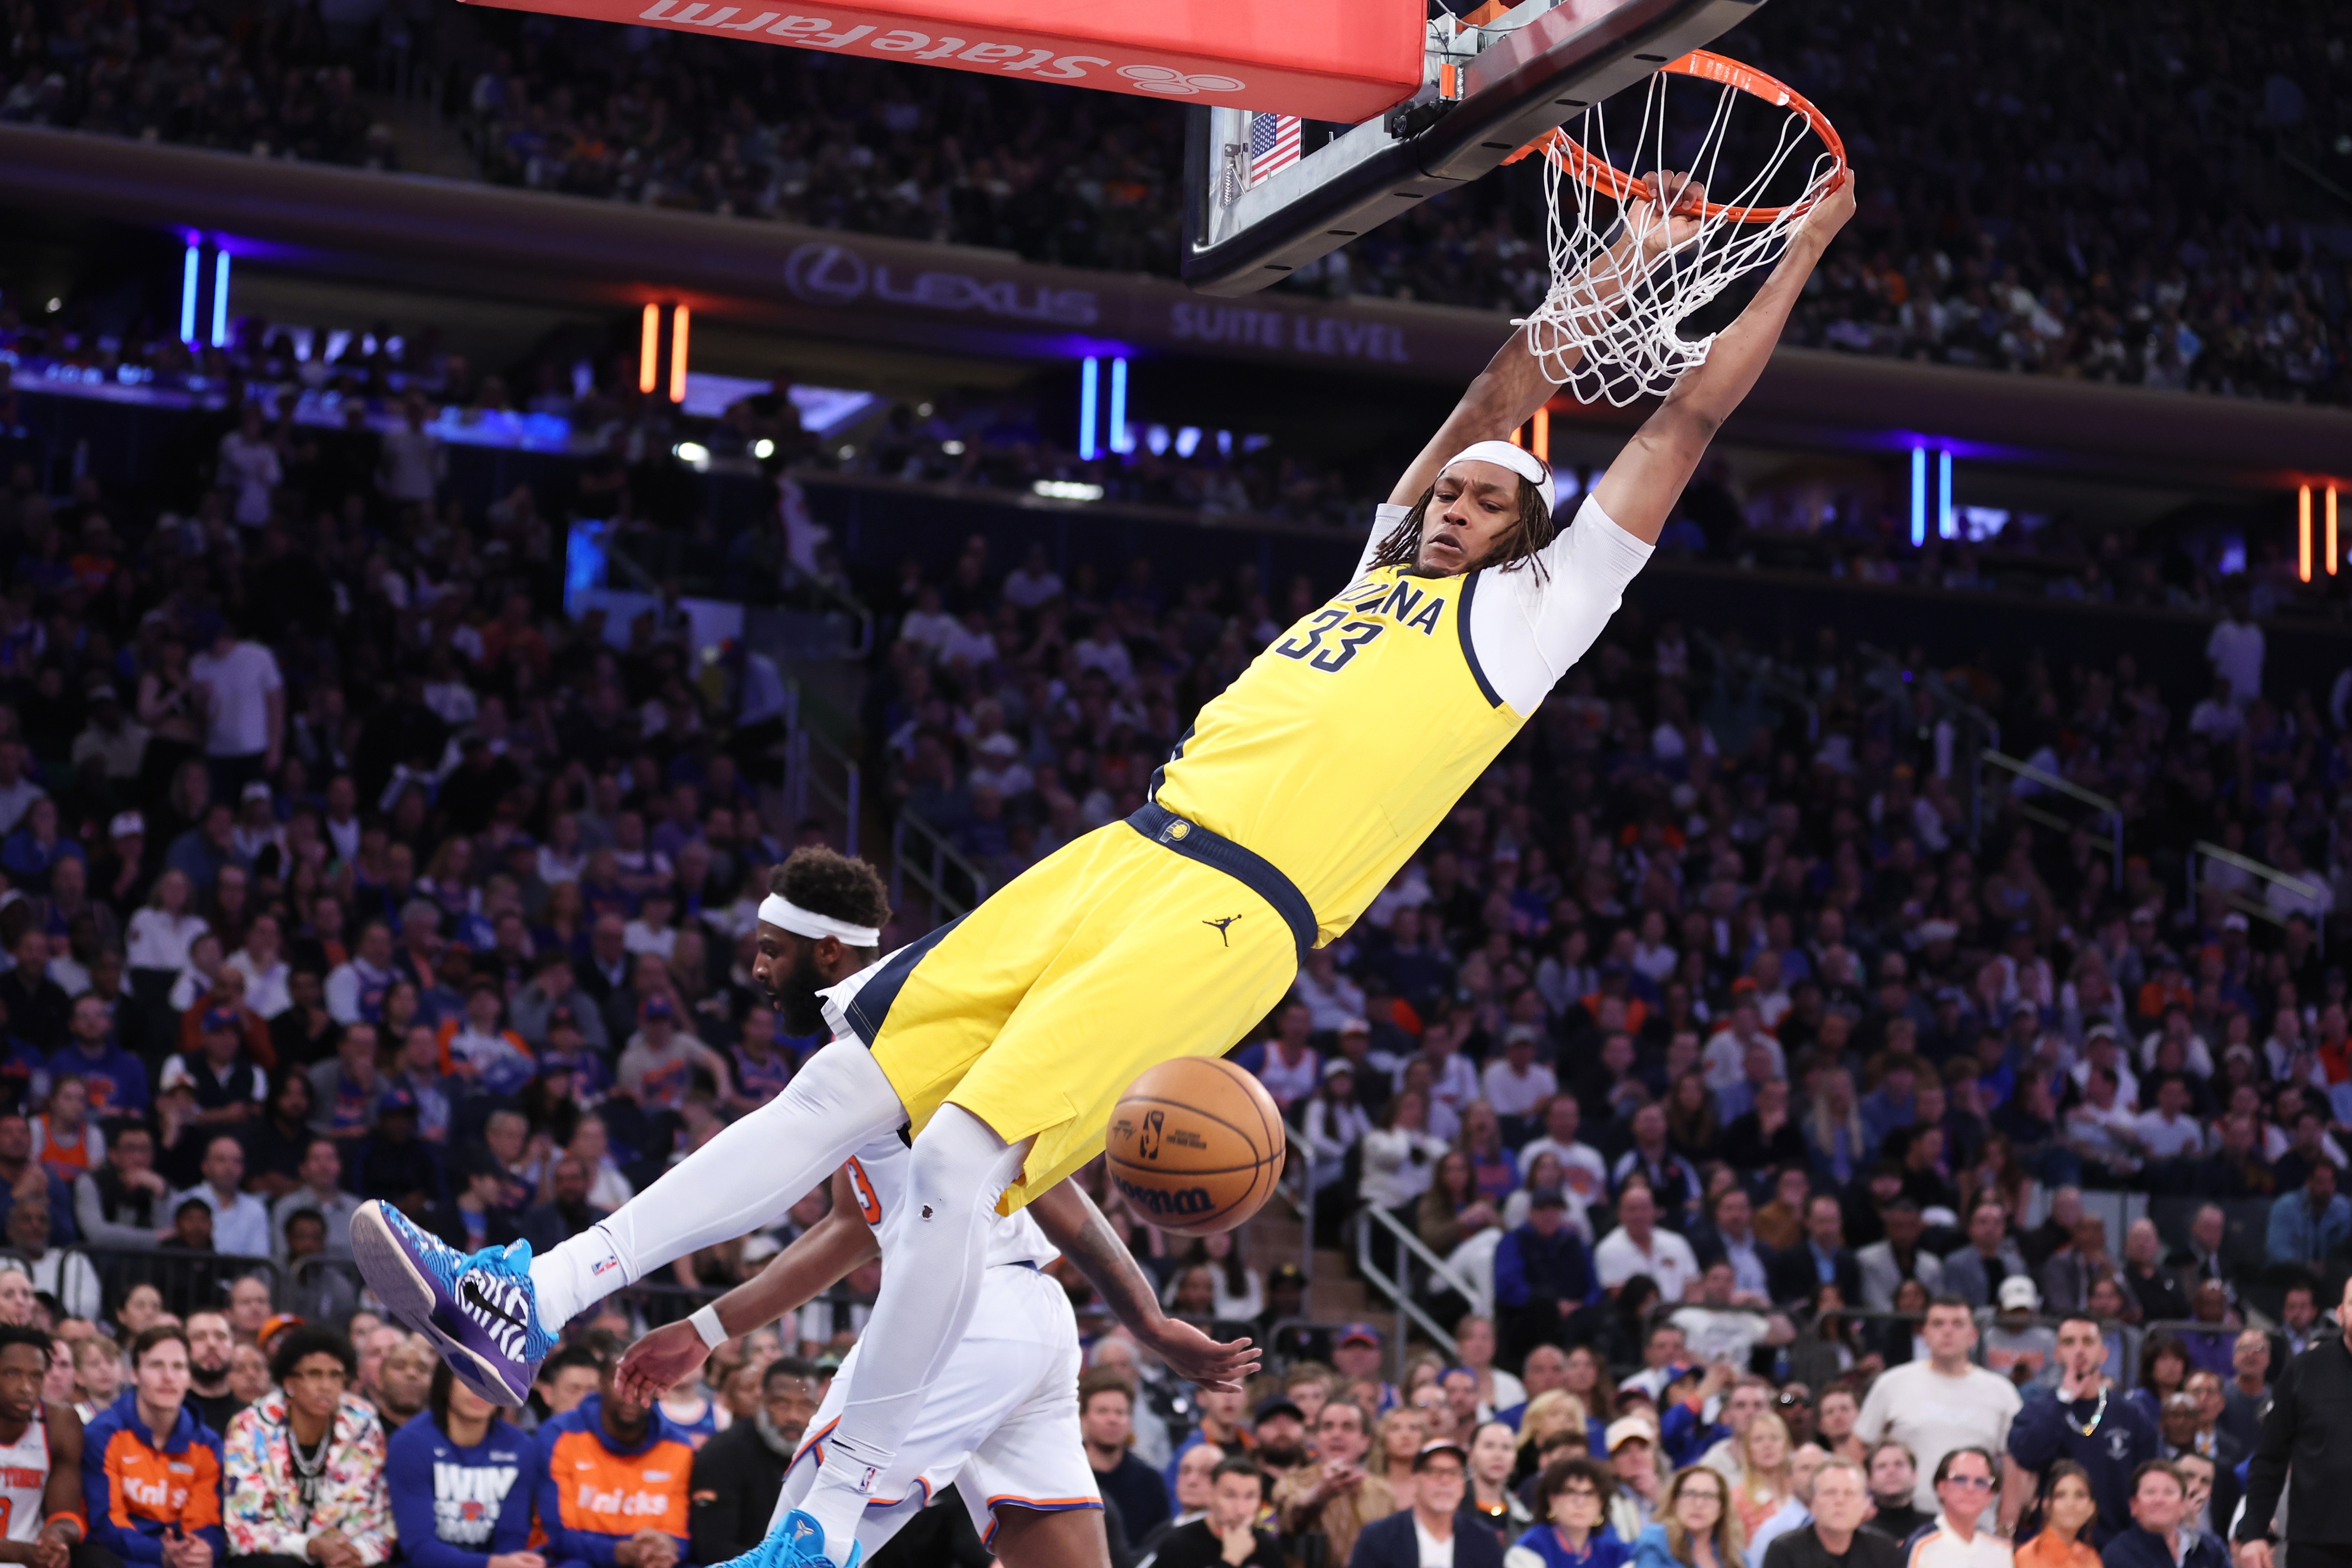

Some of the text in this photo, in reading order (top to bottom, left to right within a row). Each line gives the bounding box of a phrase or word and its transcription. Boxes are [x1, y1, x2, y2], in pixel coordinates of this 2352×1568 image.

[873, 265, 1099, 324] LEXUS
[1171, 301, 1283, 348] SUITE
[1299, 312, 1408, 363] LEVEL
[1274, 609, 1385, 674] 33
